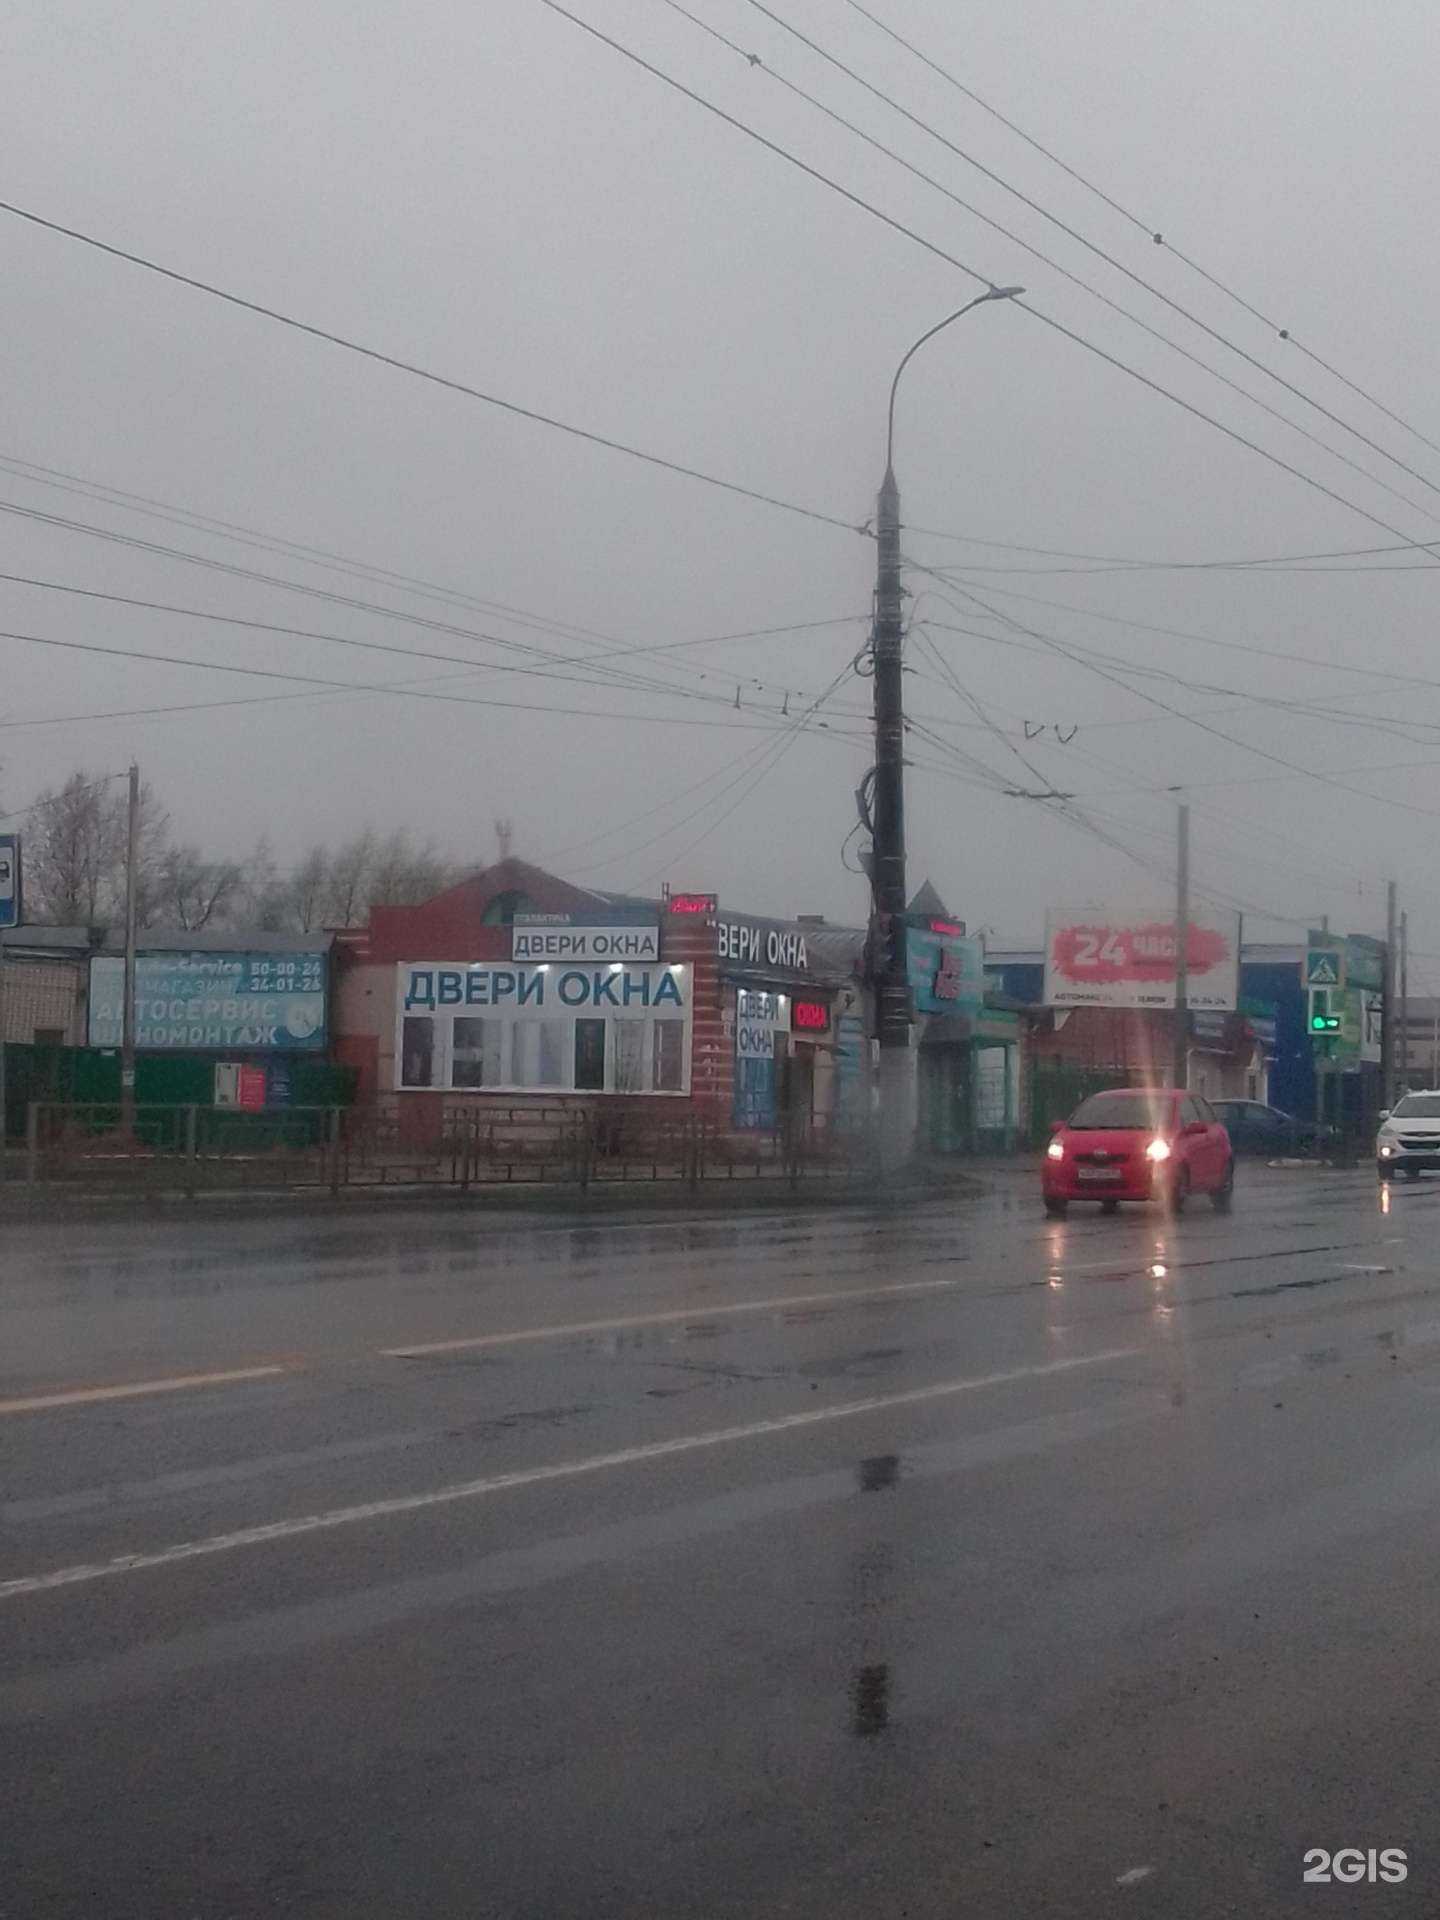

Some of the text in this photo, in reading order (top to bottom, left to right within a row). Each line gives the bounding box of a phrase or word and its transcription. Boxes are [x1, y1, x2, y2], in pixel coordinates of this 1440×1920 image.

[515, 935, 655, 957] ДВЕРИ ОКНА
[718, 923, 808, 968] ВЕРИ ОКНА
[1074, 934, 1127, 966] 24
[405, 971, 683, 1010] ДВЕРИ ОКНА
[740, 994, 779, 1020] ДВЕРИ
[740, 1027, 773, 1053] ОКНА
